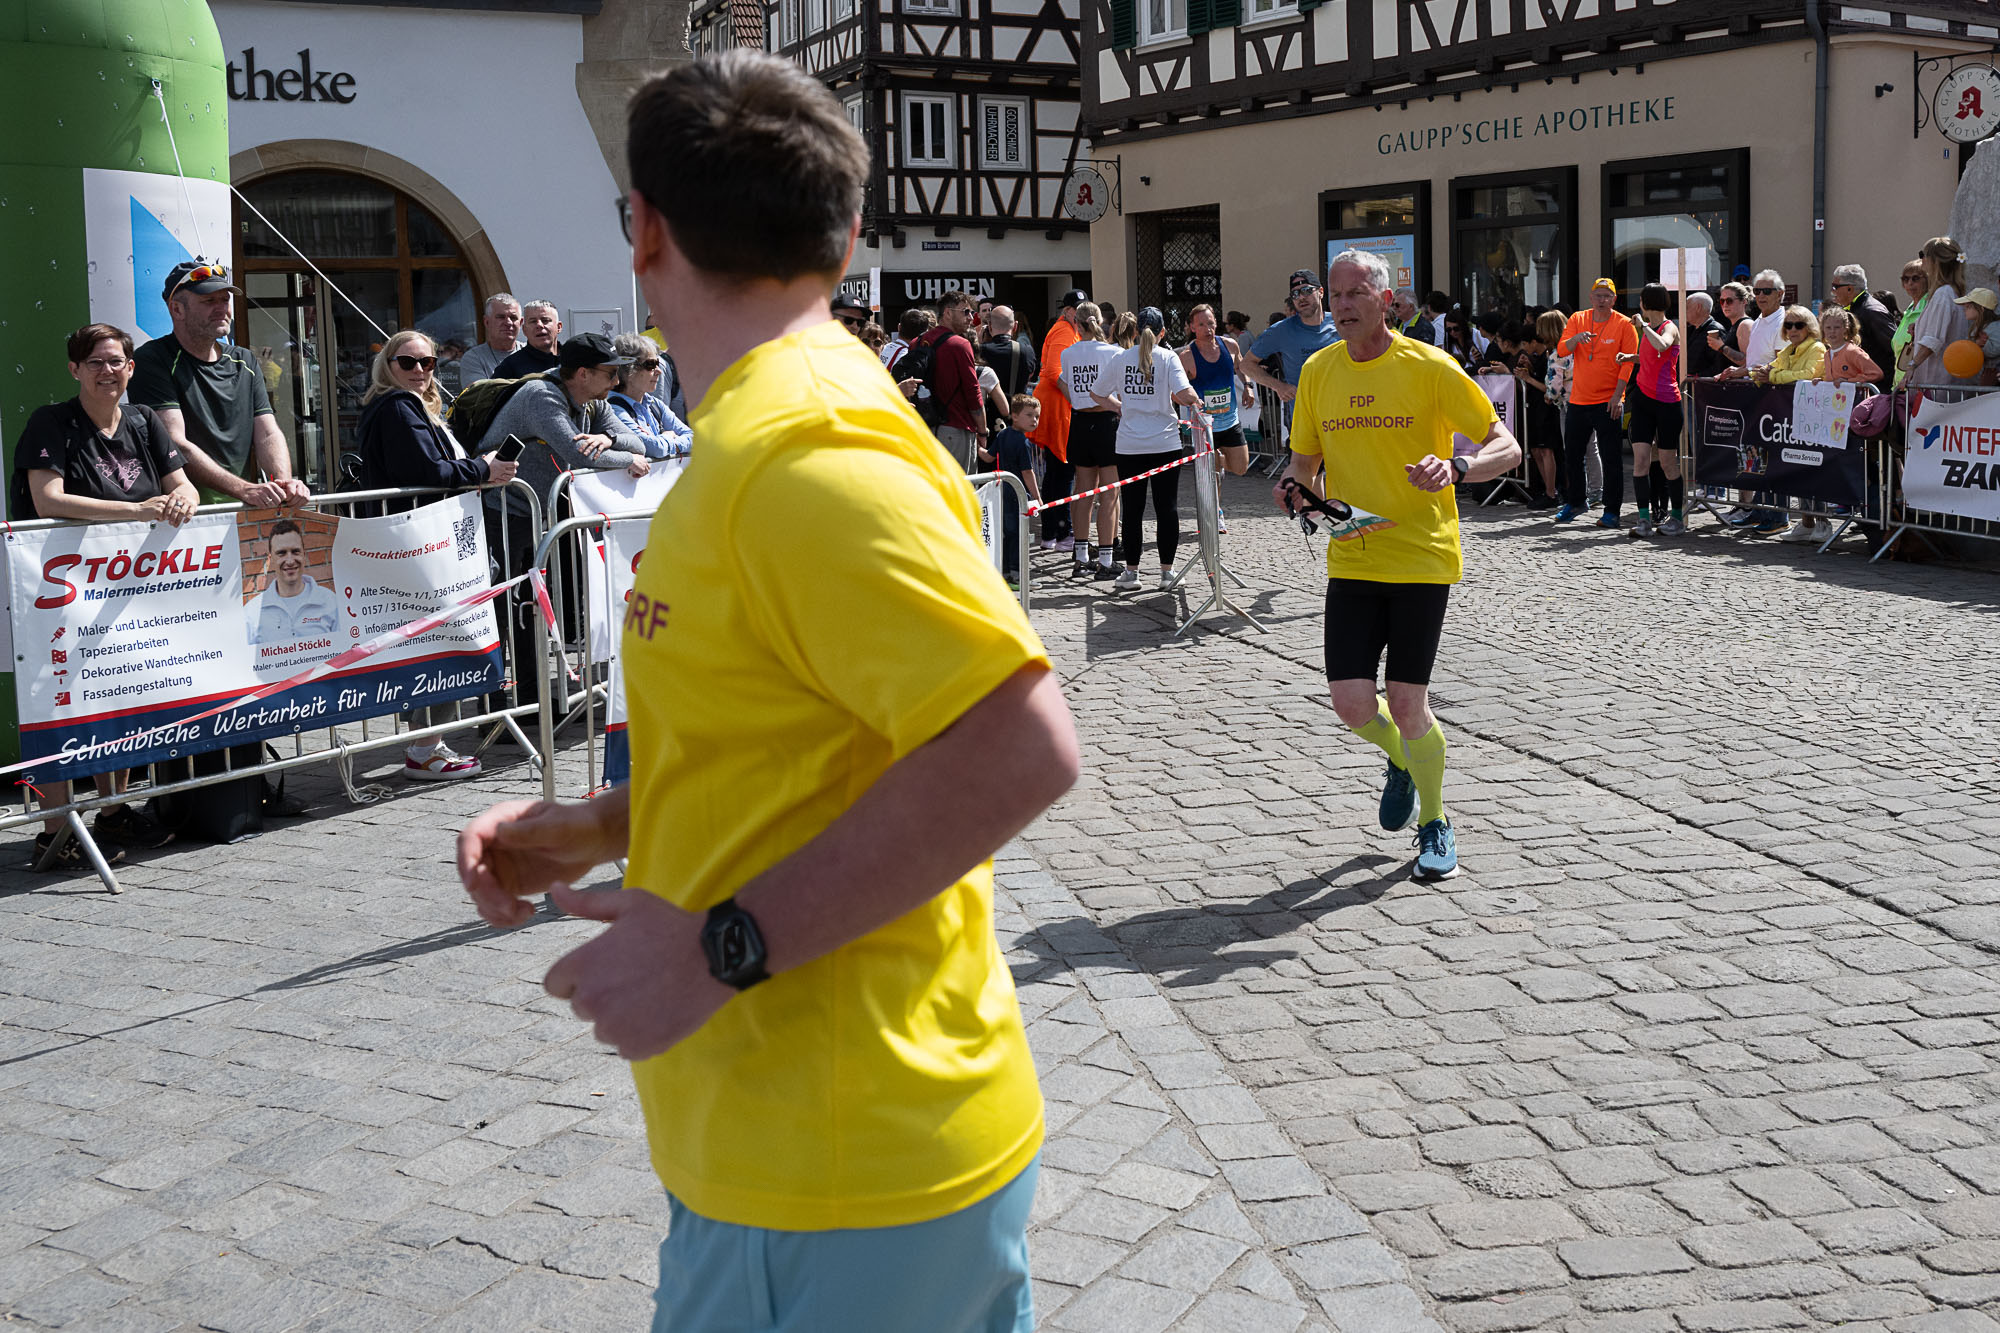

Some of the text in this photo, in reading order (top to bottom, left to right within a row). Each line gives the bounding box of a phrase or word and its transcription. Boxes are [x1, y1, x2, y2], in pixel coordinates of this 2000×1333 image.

[226, 46, 357, 104] theke
[986, 107, 998, 160] UHRMACHER
[1006, 108, 1017, 161] GOLDSCHMIED
[1377, 96, 1675, 155] GAUPP'SCHE APOTHEKE
[1942, 111, 1999, 137] APOTHEKE
[904, 278, 995, 300] UHREN
[1072, 364, 1099, 374] RIANI
[1073, 373, 1099, 384] RUN
[1125, 366, 1155, 374] RIAI
[1073, 384, 1092, 393] CLU
[1124, 386, 1155, 395] CLUB
[1350, 395, 1375, 408] FDP
[1322, 416, 1414, 432] SCHORNDORF
[351, 537, 450, 560] Kontaktieren Sie uns!
[34, 545, 223, 609] STÖCKLE
[84, 574, 223, 601] Malermeisterbetrieb
[360, 572, 485, 600] Alte Steige 1/1, 73614 Schorndorf
[362, 603, 383, 616] 0157
[623, 592, 670, 641] RF
[78, 609, 218, 637] Maler- und Lackierarbeiten
[79, 636, 169, 659] Tapezierarbeiten
[261, 638, 332, 657] Michael Stöckle
[81, 649, 223, 680] Dekorative Wandtechniken
[253, 651, 342, 671] Maler- und Lackierermeister
[83, 674, 193, 701] Fassadengestaltung
[58, 663, 491, 764] Schwäbische Wertarbeit für Ihr Zuhause!
